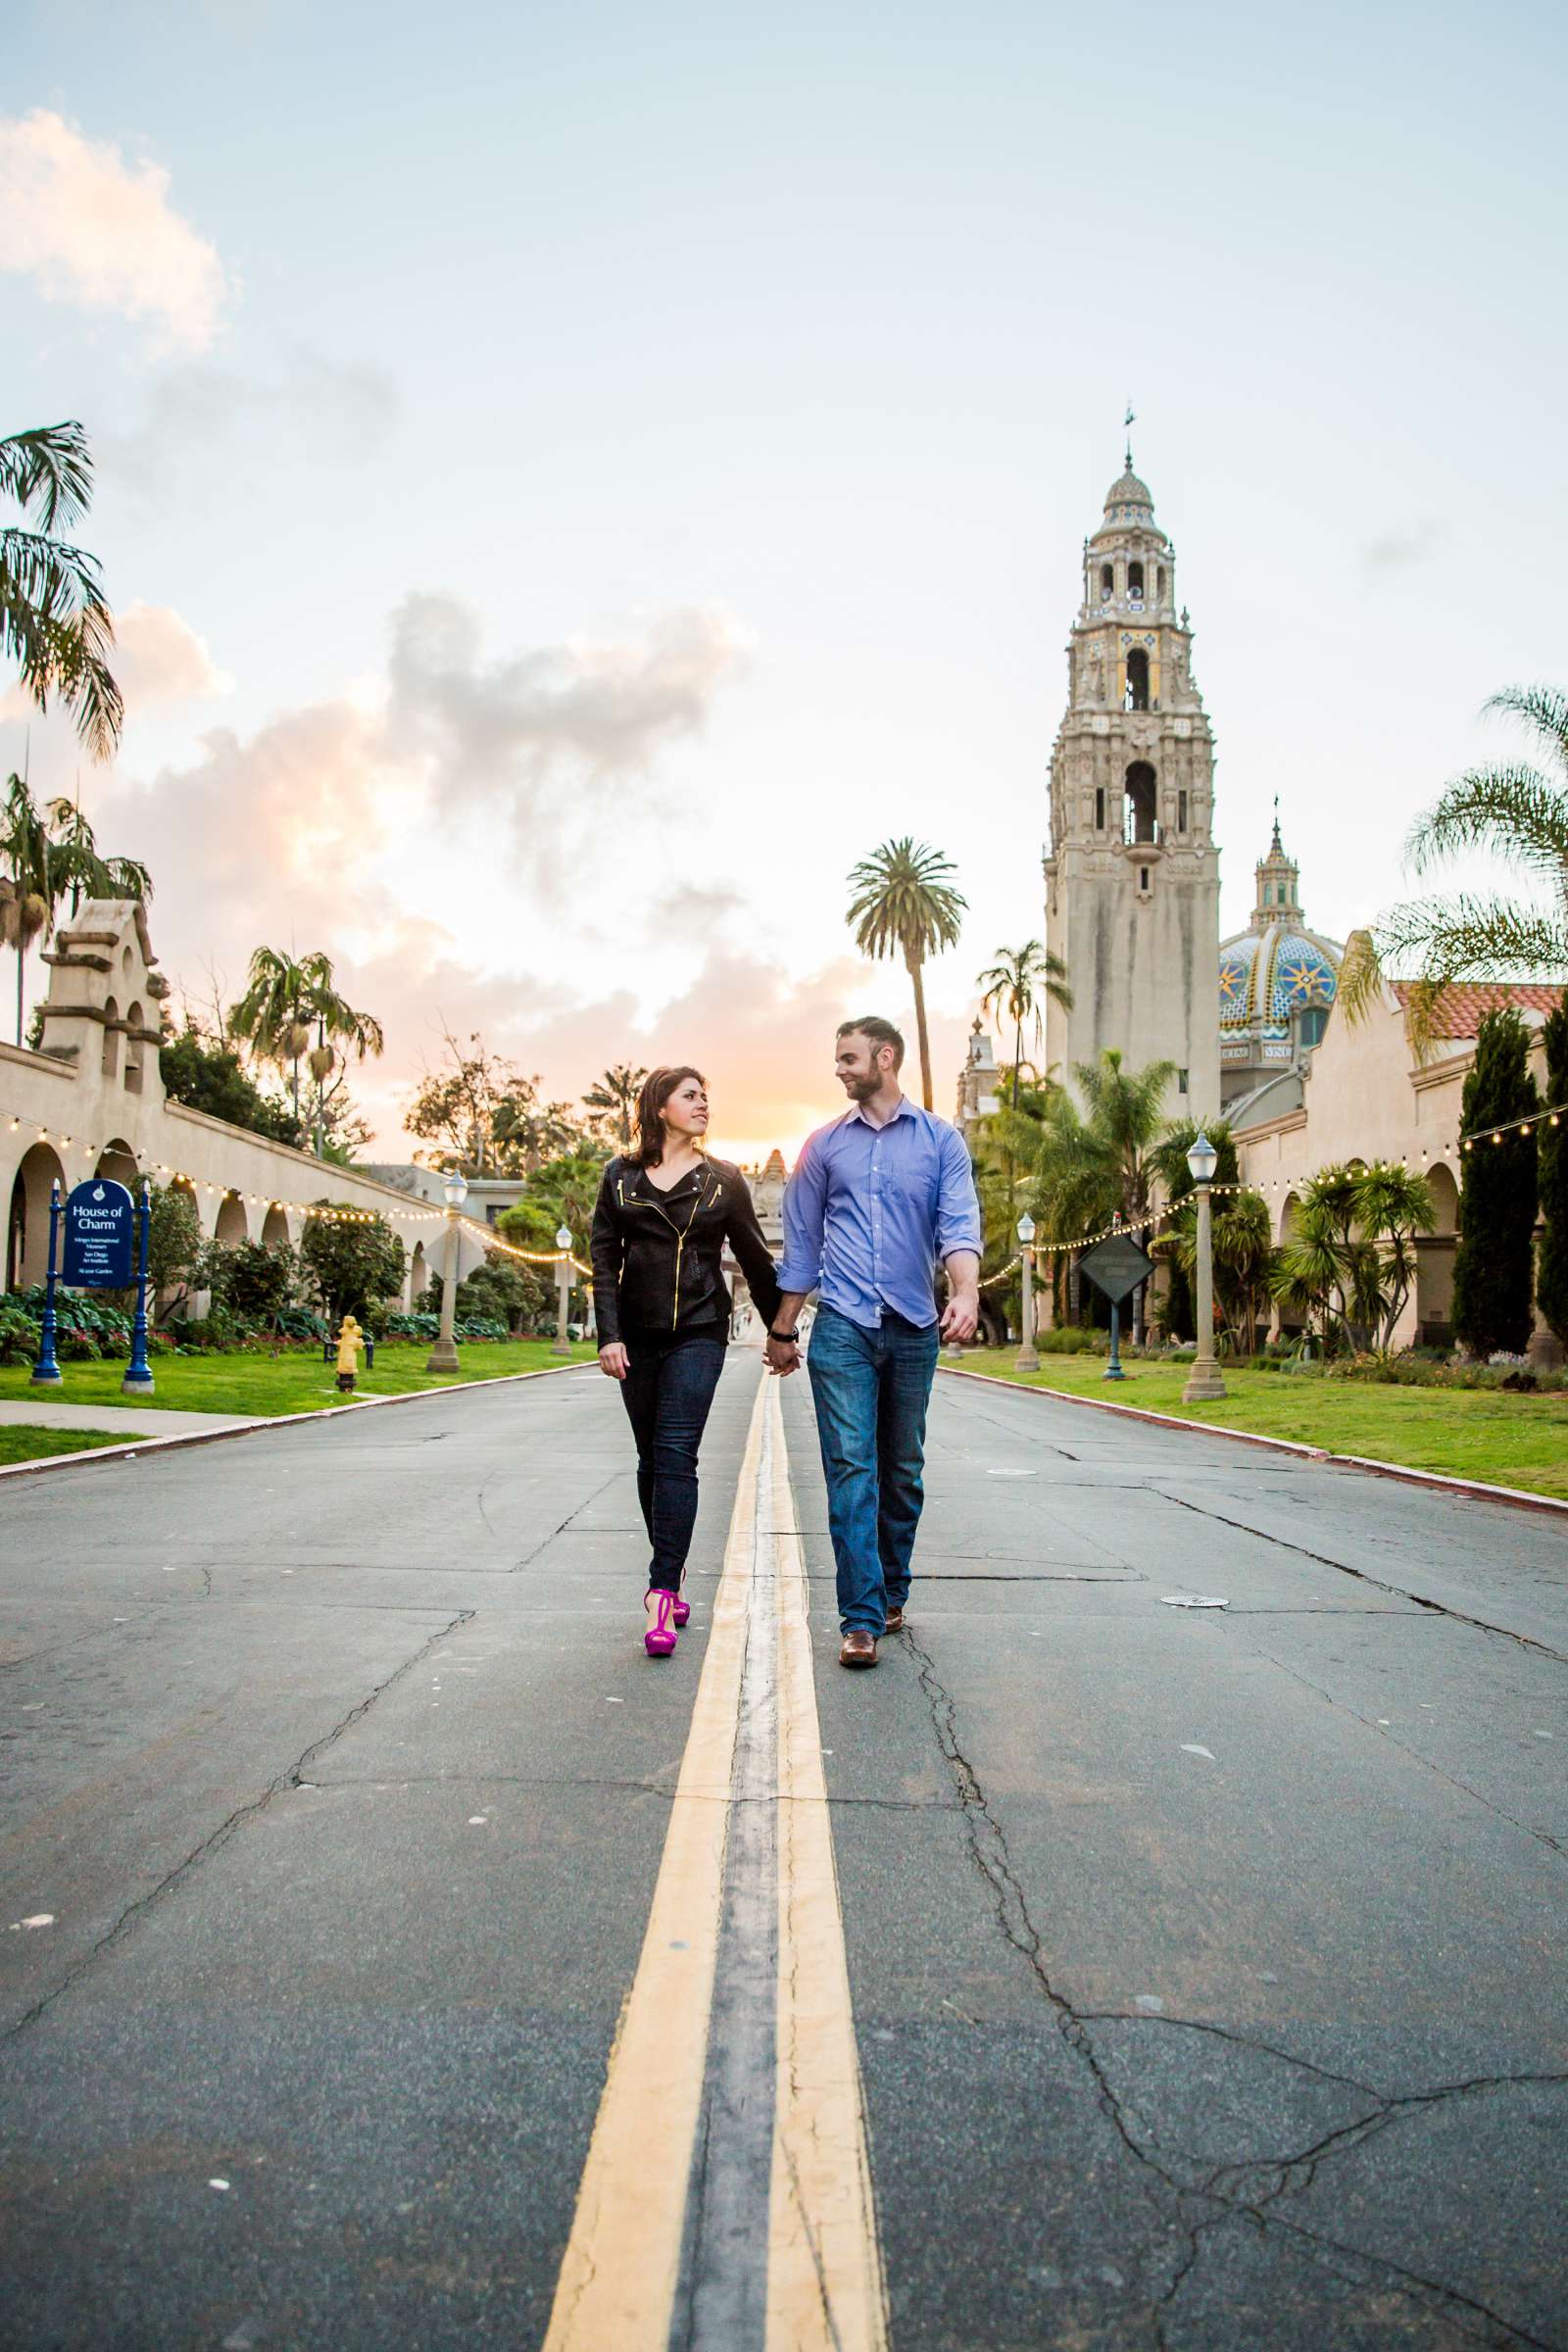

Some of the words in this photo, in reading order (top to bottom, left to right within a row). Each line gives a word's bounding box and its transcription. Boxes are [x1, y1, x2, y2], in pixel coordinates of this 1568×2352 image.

[74, 1205, 109, 1217] House
[111, 1206, 122, 1217] of
[78, 1218, 116, 1230] Charm
